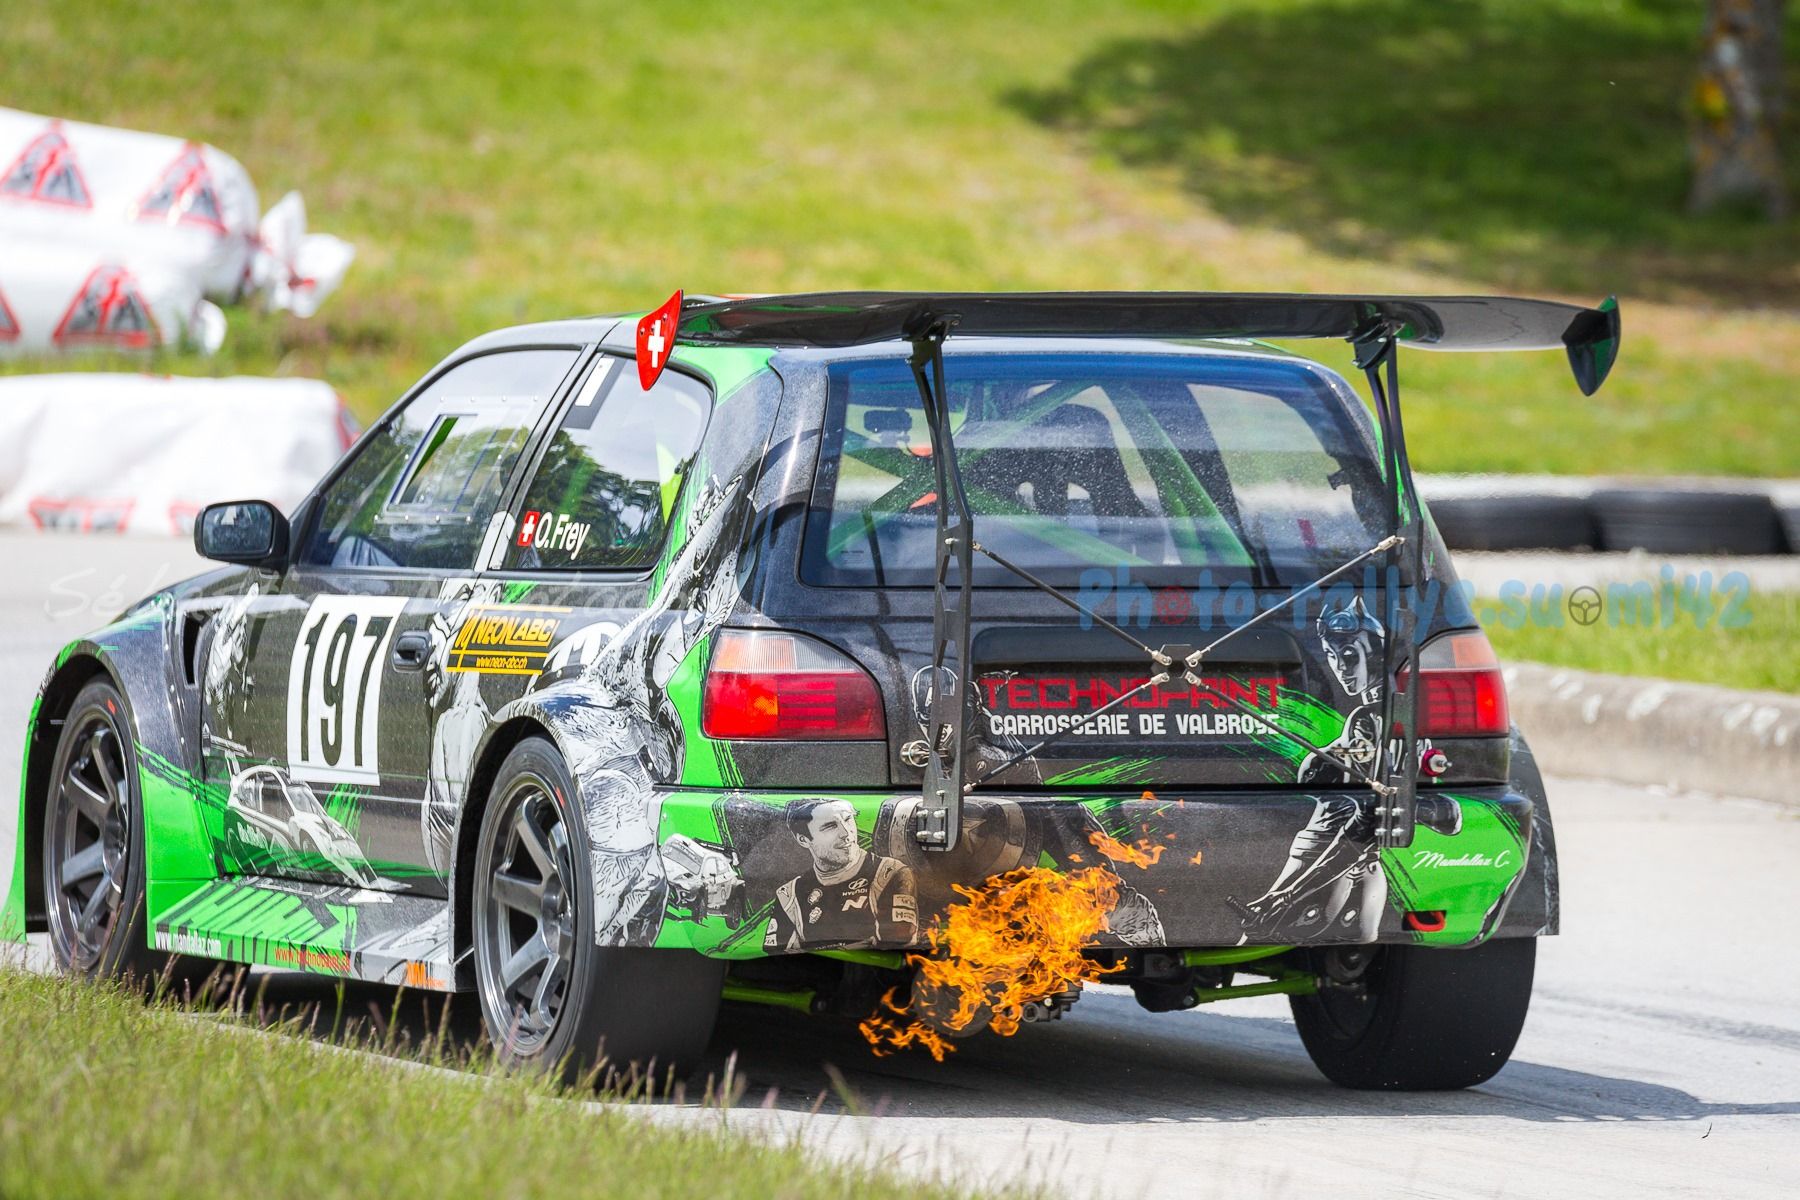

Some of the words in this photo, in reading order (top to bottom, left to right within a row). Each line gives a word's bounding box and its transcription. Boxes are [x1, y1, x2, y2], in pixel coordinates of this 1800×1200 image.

[534, 511, 591, 560] O.Frey
[301, 612, 394, 767] 197
[990, 713, 1131, 736] CARROSSERIE
[1140, 713, 1166, 736] DE
